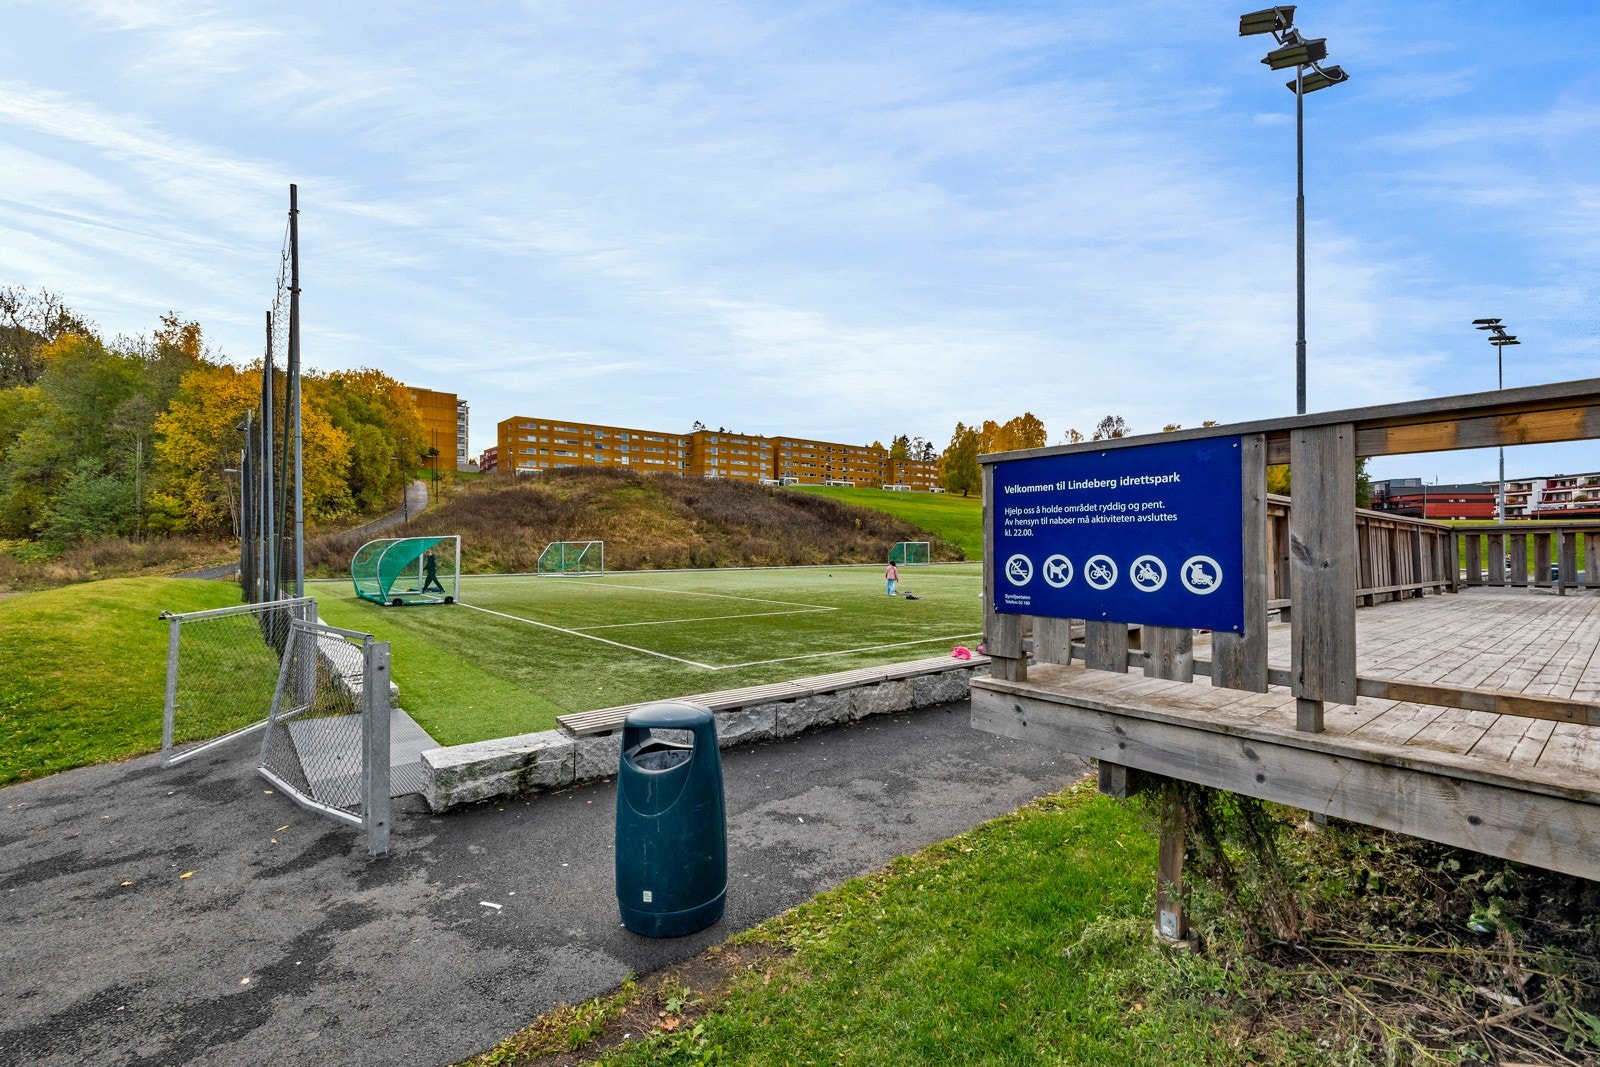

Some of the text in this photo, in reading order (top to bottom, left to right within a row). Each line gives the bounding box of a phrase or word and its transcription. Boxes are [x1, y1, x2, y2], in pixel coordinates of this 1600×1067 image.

[1004, 472, 1180, 494] Velkommen til Lindeberg idrettspark
[1004, 500, 1166, 517] Hjelp oss å holde området ryddig og pent.
[1004, 512, 1178, 527] Av hensyn til naboer må aktiviteten avsluttes
[1004, 528, 1034, 537] kl. 22.00.
